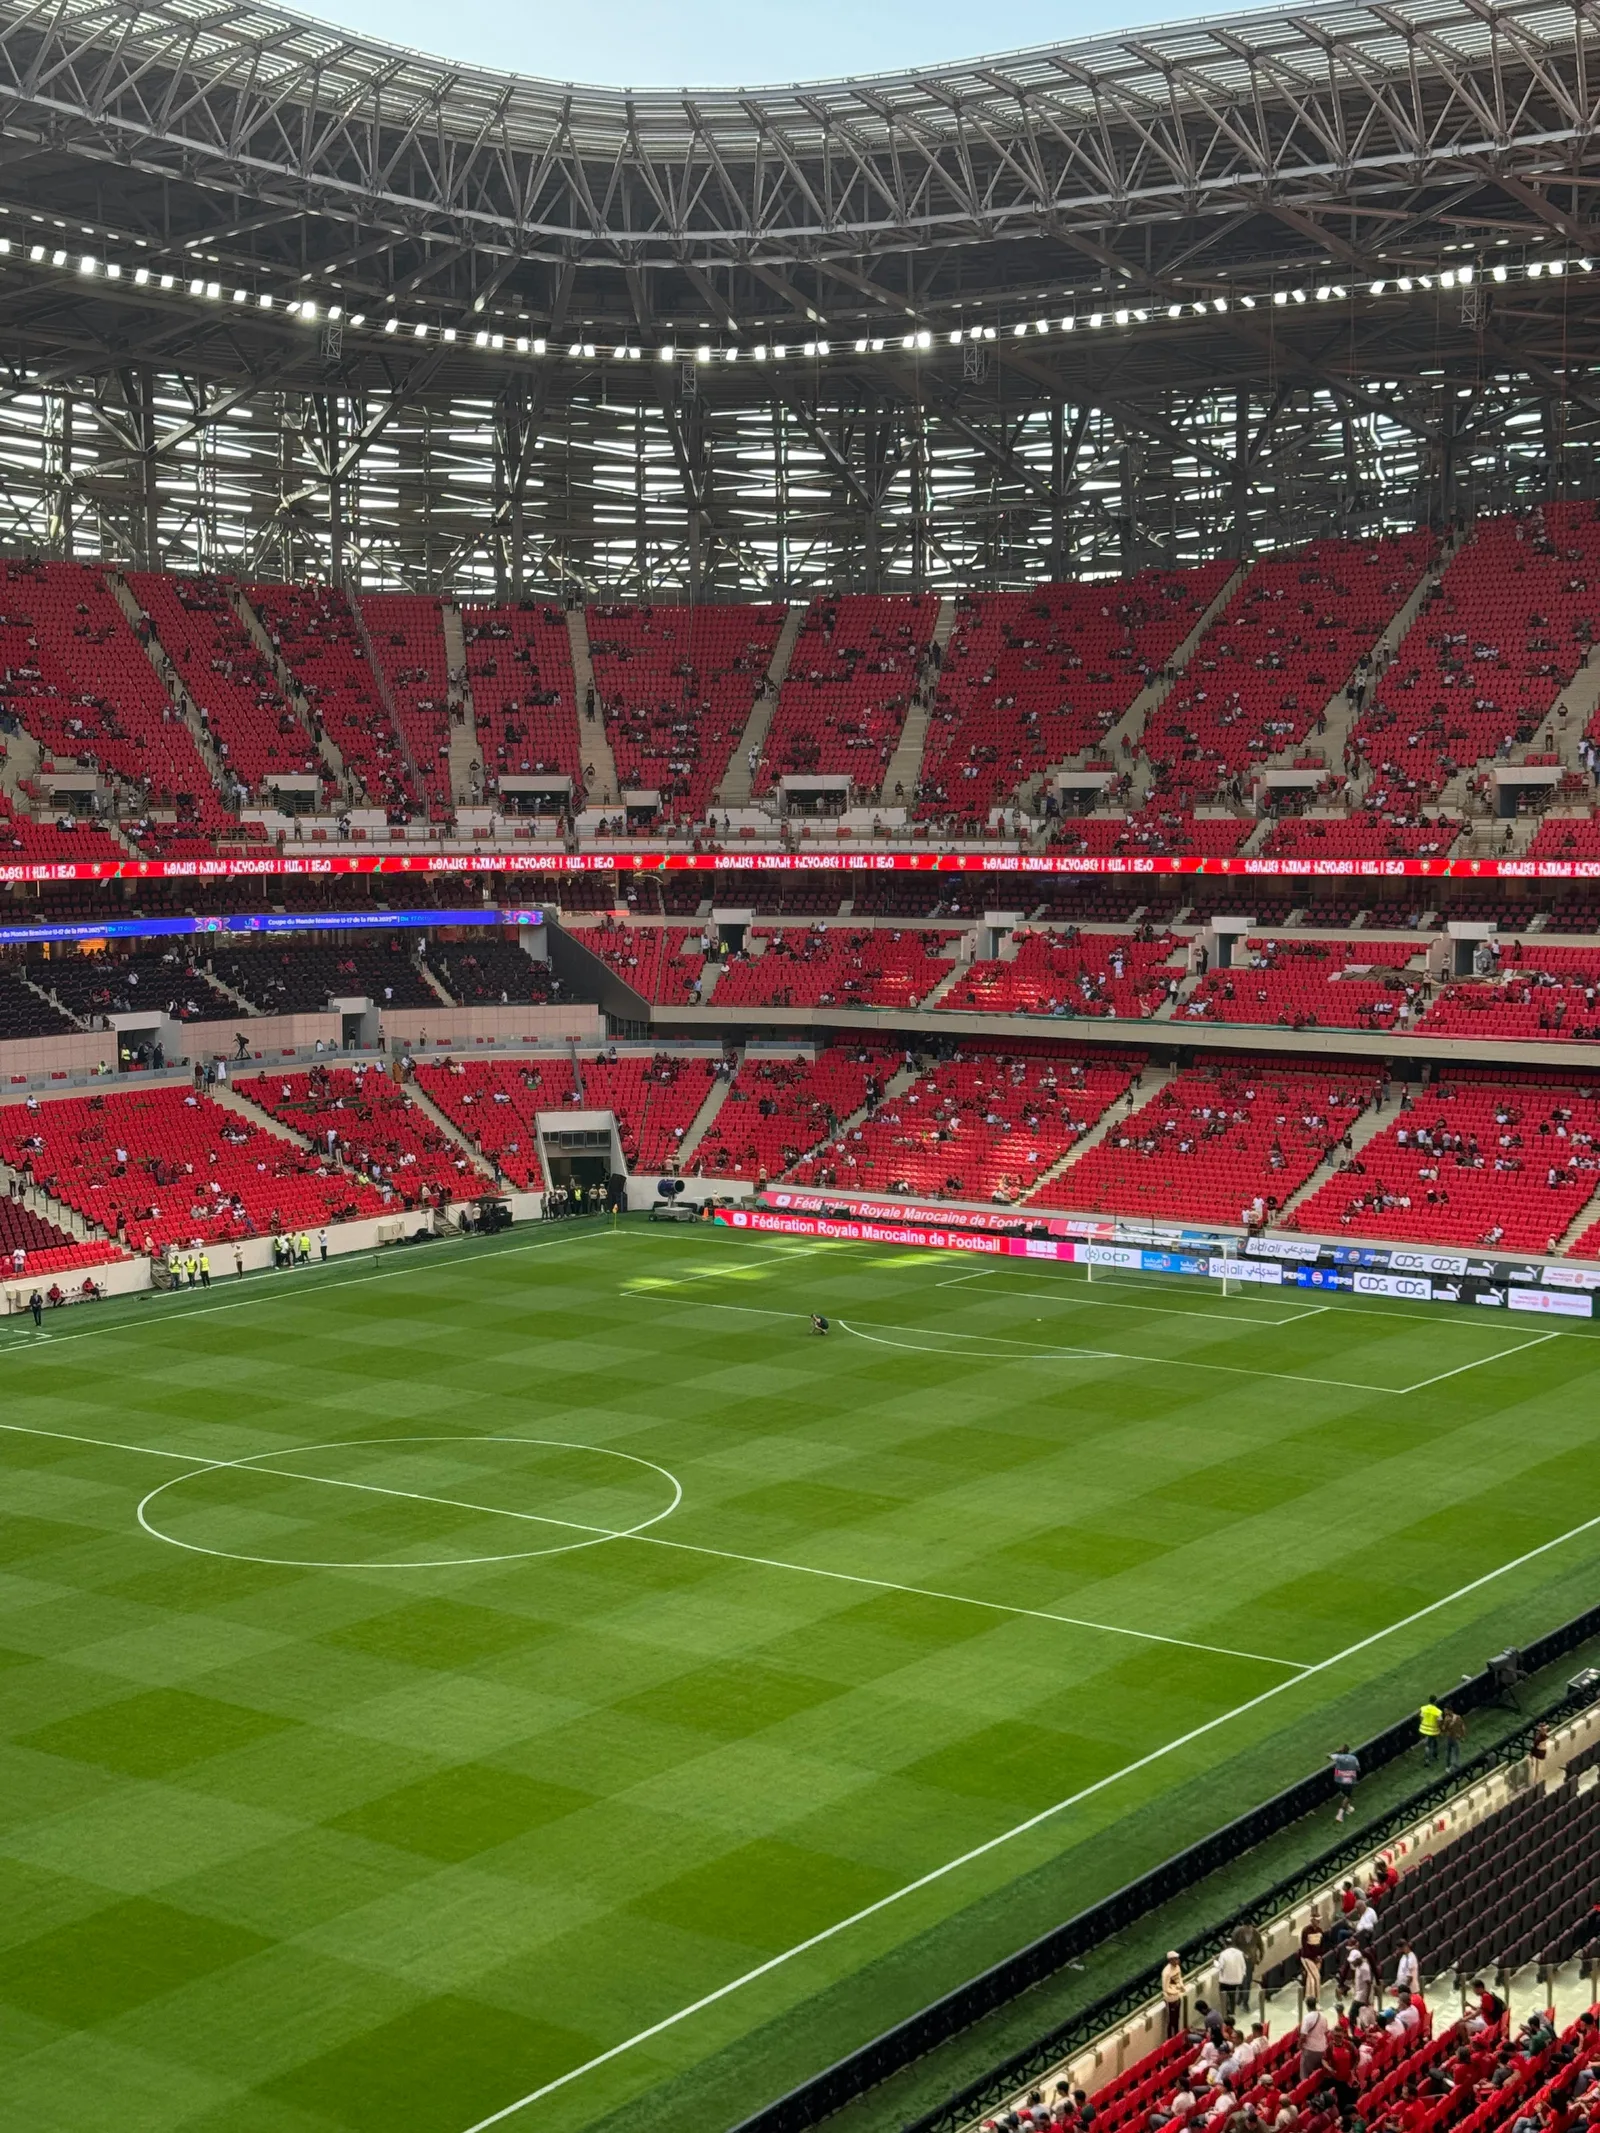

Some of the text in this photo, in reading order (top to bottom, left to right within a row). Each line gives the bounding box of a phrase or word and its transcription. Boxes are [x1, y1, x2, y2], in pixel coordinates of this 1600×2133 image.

[860, 1204, 900, 1220] Royale
[903, 1208, 967, 1224] Marocaine
[970, 1214, 986, 1226] de
[752, 1214, 1000, 1252] Fédération Royale Marocaine de Football
[1102, 1251, 1130, 1262] OCP
[1394, 1254, 1424, 1269] CDG
[1431, 1258, 1460, 1272] CDG
[1360, 1276, 1388, 1292] CDG
[1396, 1280, 1426, 1296] CDG
